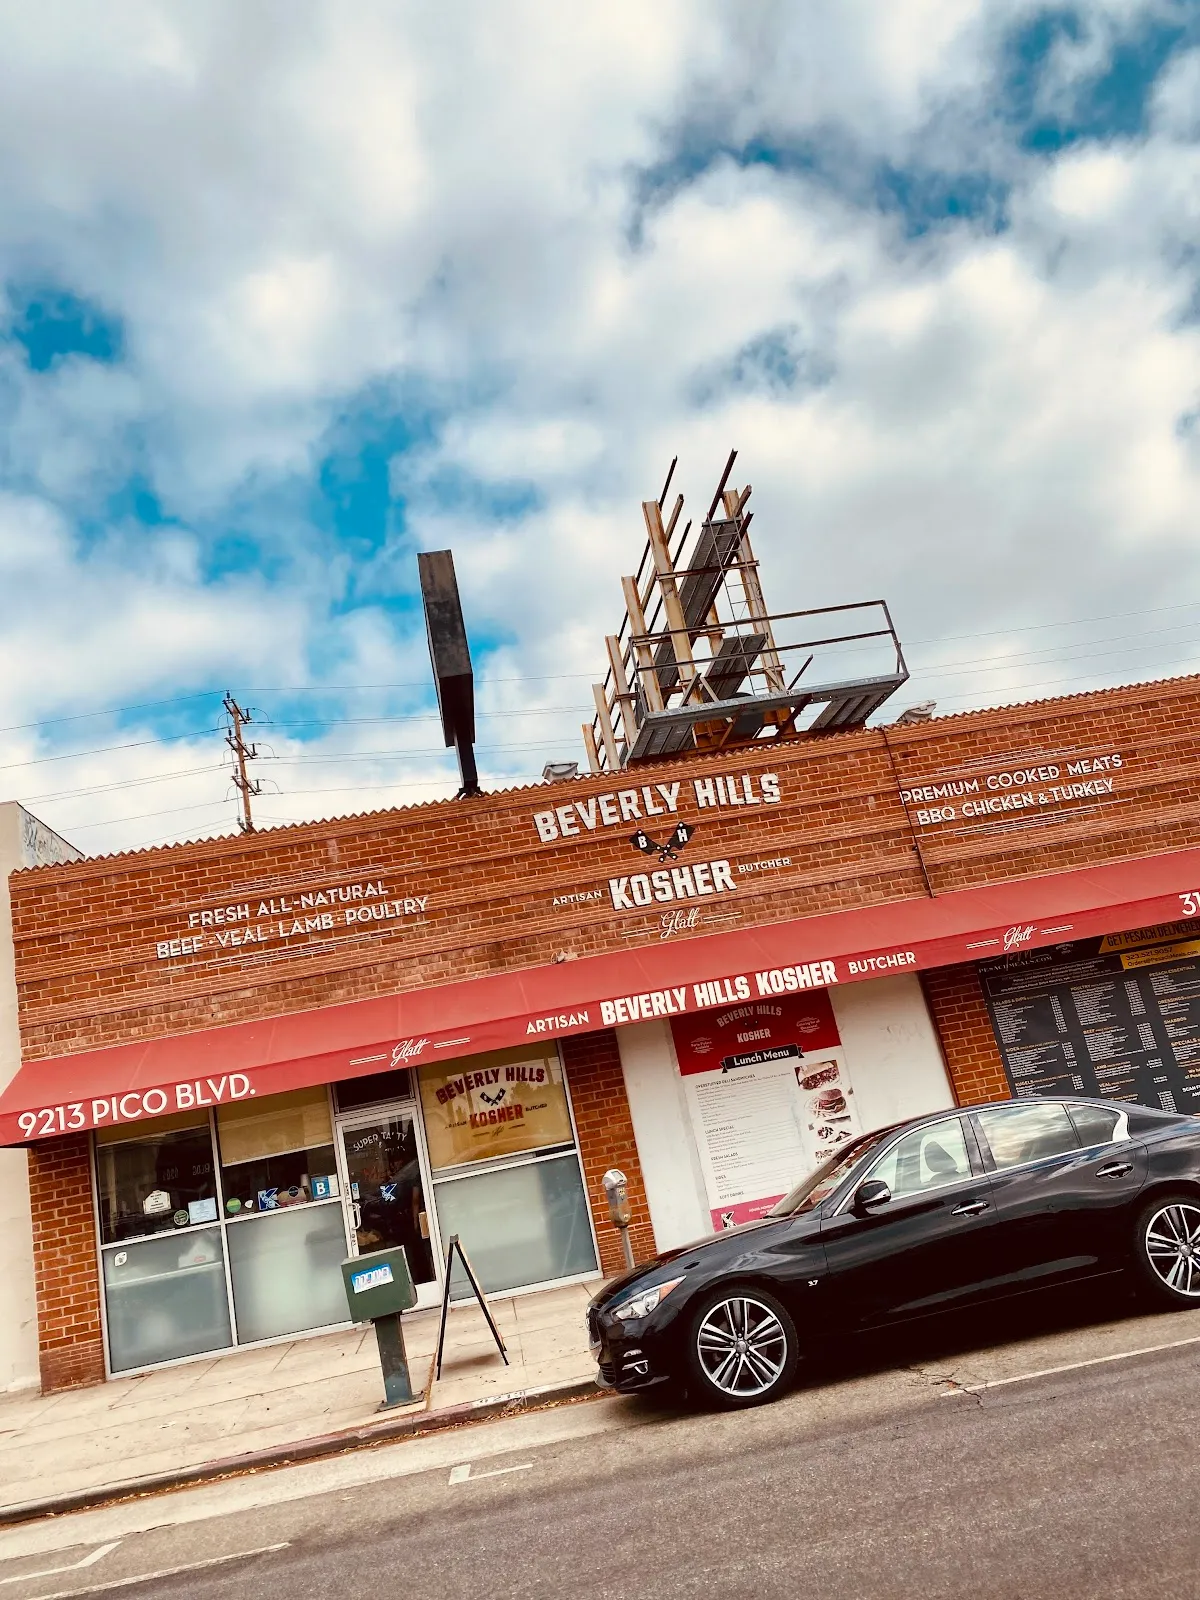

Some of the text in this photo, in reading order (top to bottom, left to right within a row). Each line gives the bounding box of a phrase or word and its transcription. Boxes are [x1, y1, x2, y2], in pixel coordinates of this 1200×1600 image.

[899, 754, 1123, 804] PREMIUM COOKED MEATS
[533, 773, 782, 843] BEVERLY HILLS
[916, 778, 1114, 826] BBQ CHICKEN & TURKEY
[637, 835, 648, 849] B
[677, 828, 688, 843] H
[552, 857, 792, 911] ARTISAN KOSHER BUTCHER
[188, 881, 388, 928] FRESH ALL-NATURAL
[156, 896, 428, 959] BEEF VEAL LAMB POULTRY
[660, 907, 701, 939] Glatt
[1107, 920, 1200, 947] GET PESACH DELIVERE
[1003, 926, 1038, 951] Glatt
[525, 951, 917, 1035] ARTISAN BEVERLY HILLS KOSHER BUTCHER
[716, 1005, 783, 1028] BEVERLY HILLS
[736, 1028, 772, 1043] KOSHER
[390, 1038, 431, 1067] Glatt
[733, 1048, 790, 1066] Lunch Menu
[435, 1067, 545, 1105] BEVERLY HILLS
[17, 1073, 256, 1138] 9213 PICO BLVD.
[469, 1104, 524, 1129] KOSHER
[353, 1133, 378, 1152] SUPER
[381, 1131, 407, 1141] TATY
[316, 1182, 326, 1195] B
